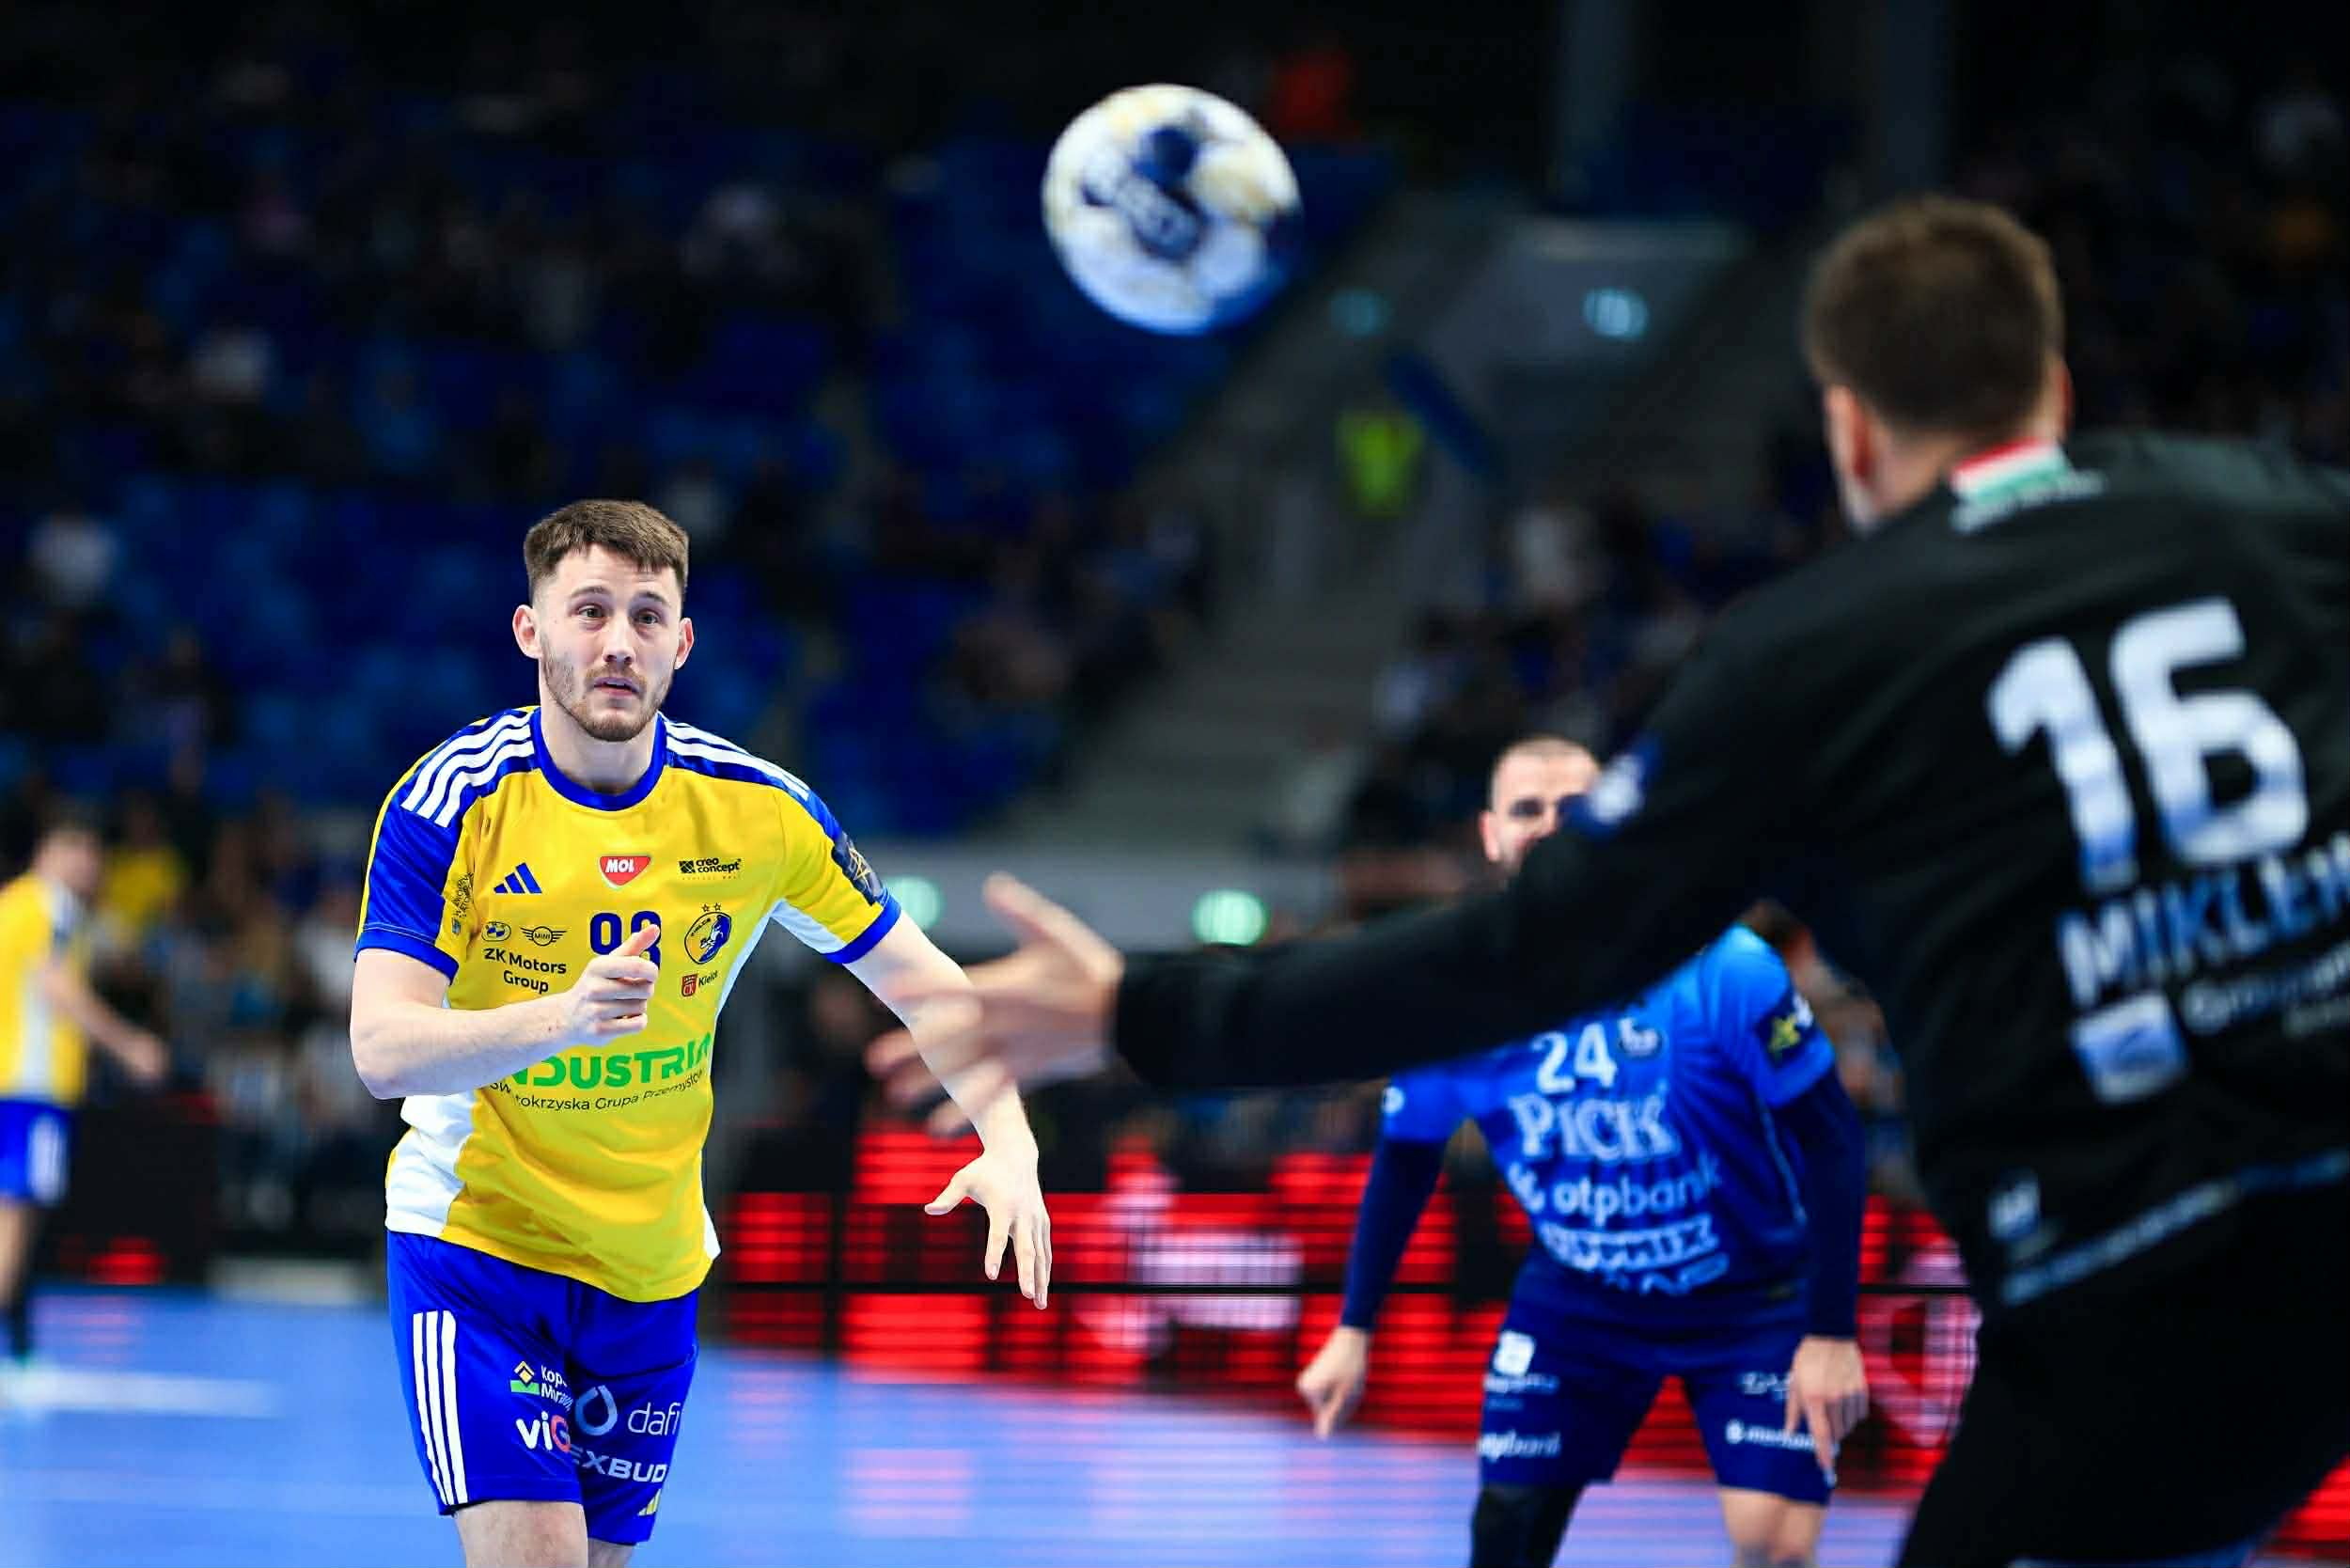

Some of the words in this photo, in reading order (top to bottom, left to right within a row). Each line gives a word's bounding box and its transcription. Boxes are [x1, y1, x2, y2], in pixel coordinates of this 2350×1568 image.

[1987, 596, 2309, 889] 16
[605, 859, 634, 873] MOL
[696, 857, 719, 866] creo
[697, 860, 739, 873] concept
[2057, 831, 2350, 1008] MIKLE
[484, 948, 506, 964] ZK
[509, 952, 567, 974] Motors
[504, 970, 549, 995] Group
[511, 1032, 712, 1090] DUSTRIA
[1529, 1022, 1619, 1094] 24
[1508, 1092, 1682, 1162] PICK
[628, 1402, 682, 1435] dafi
